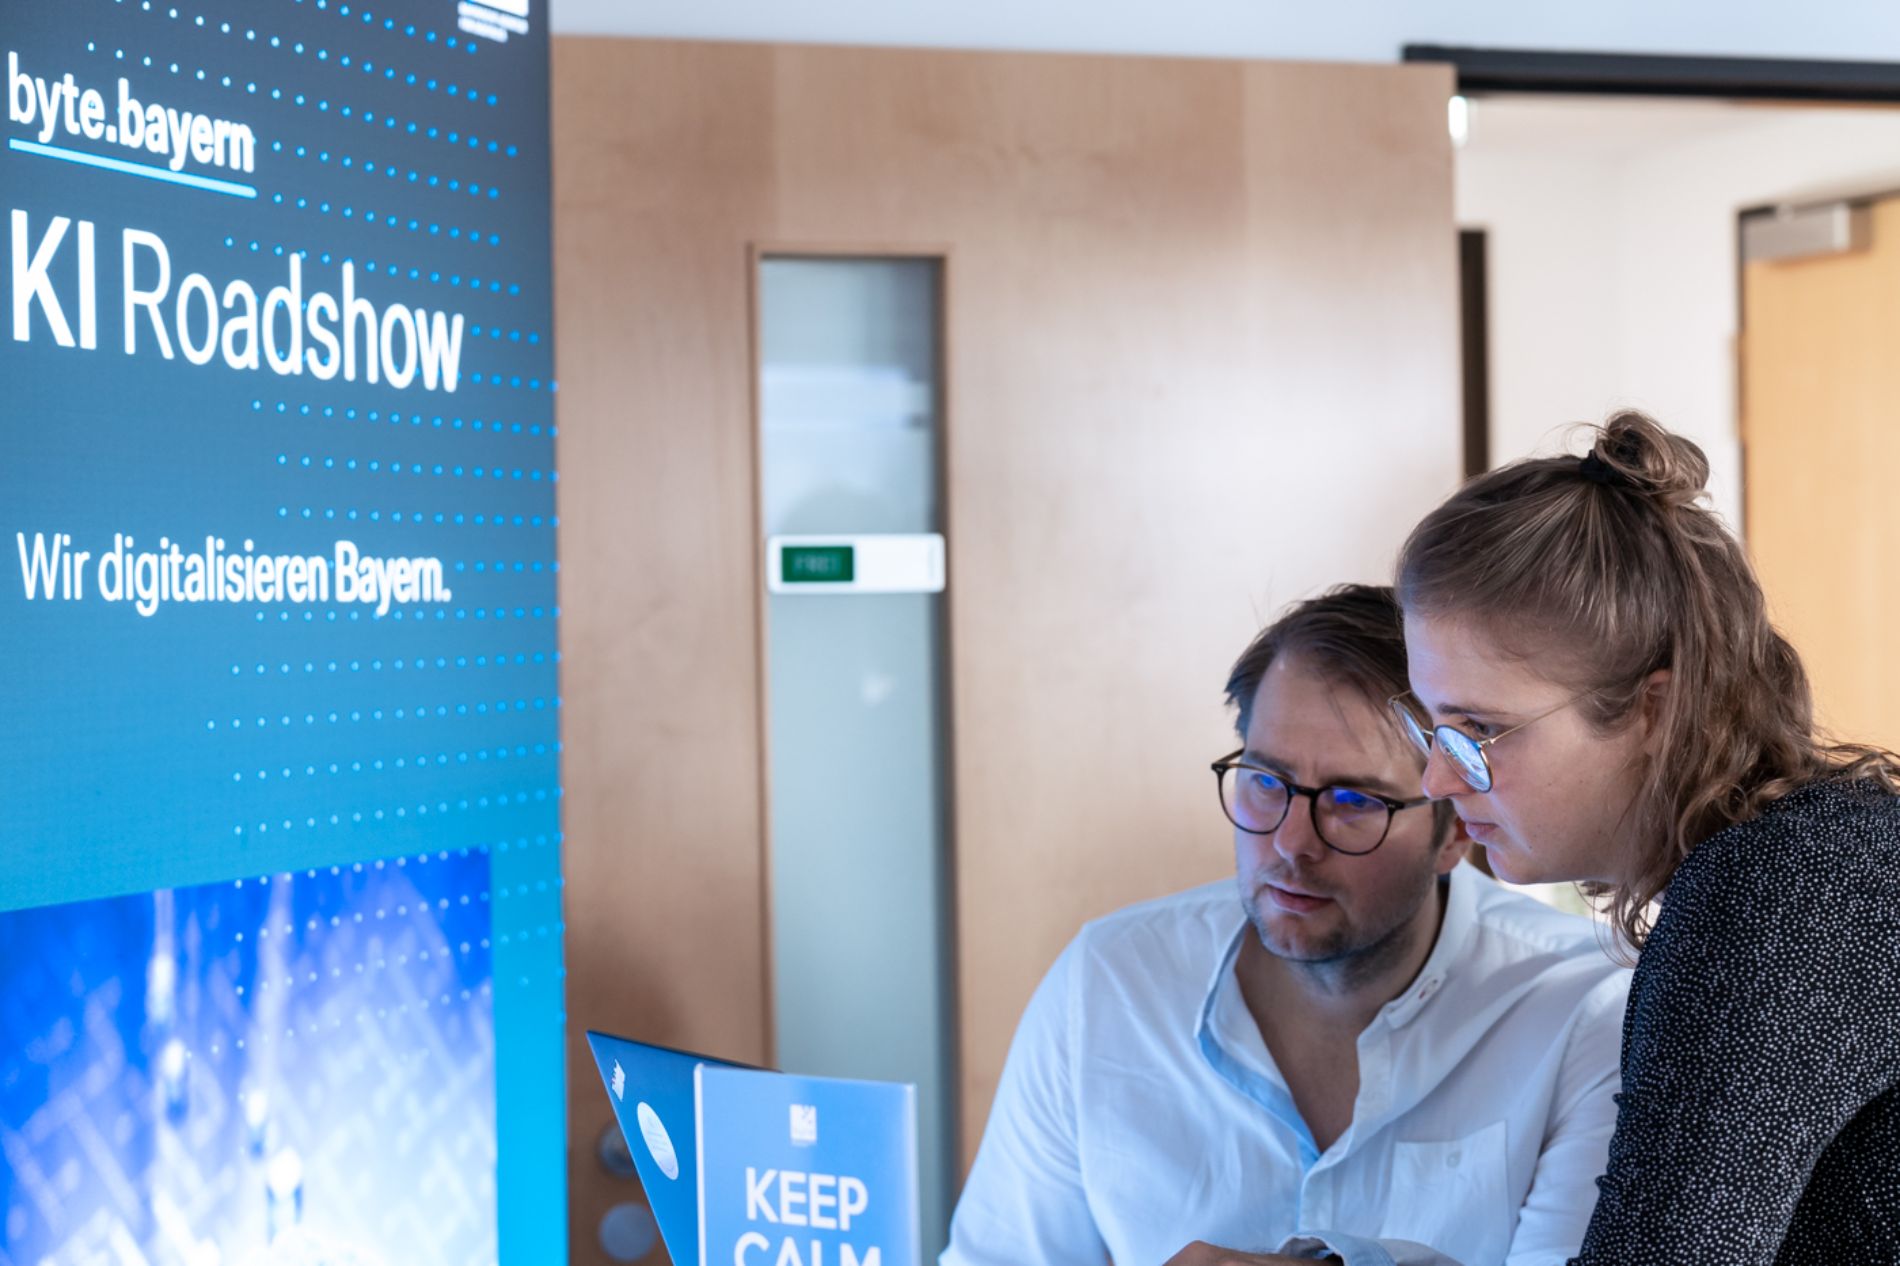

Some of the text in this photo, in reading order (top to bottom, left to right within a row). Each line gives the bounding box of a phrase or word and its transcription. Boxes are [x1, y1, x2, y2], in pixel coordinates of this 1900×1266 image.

[8, 51, 255, 172] byte.bayern
[11, 209, 464, 393] KI Roadshow
[17, 532, 452, 616] Wir digitalisieren Bayern.
[746, 1167, 868, 1231] KEEP
